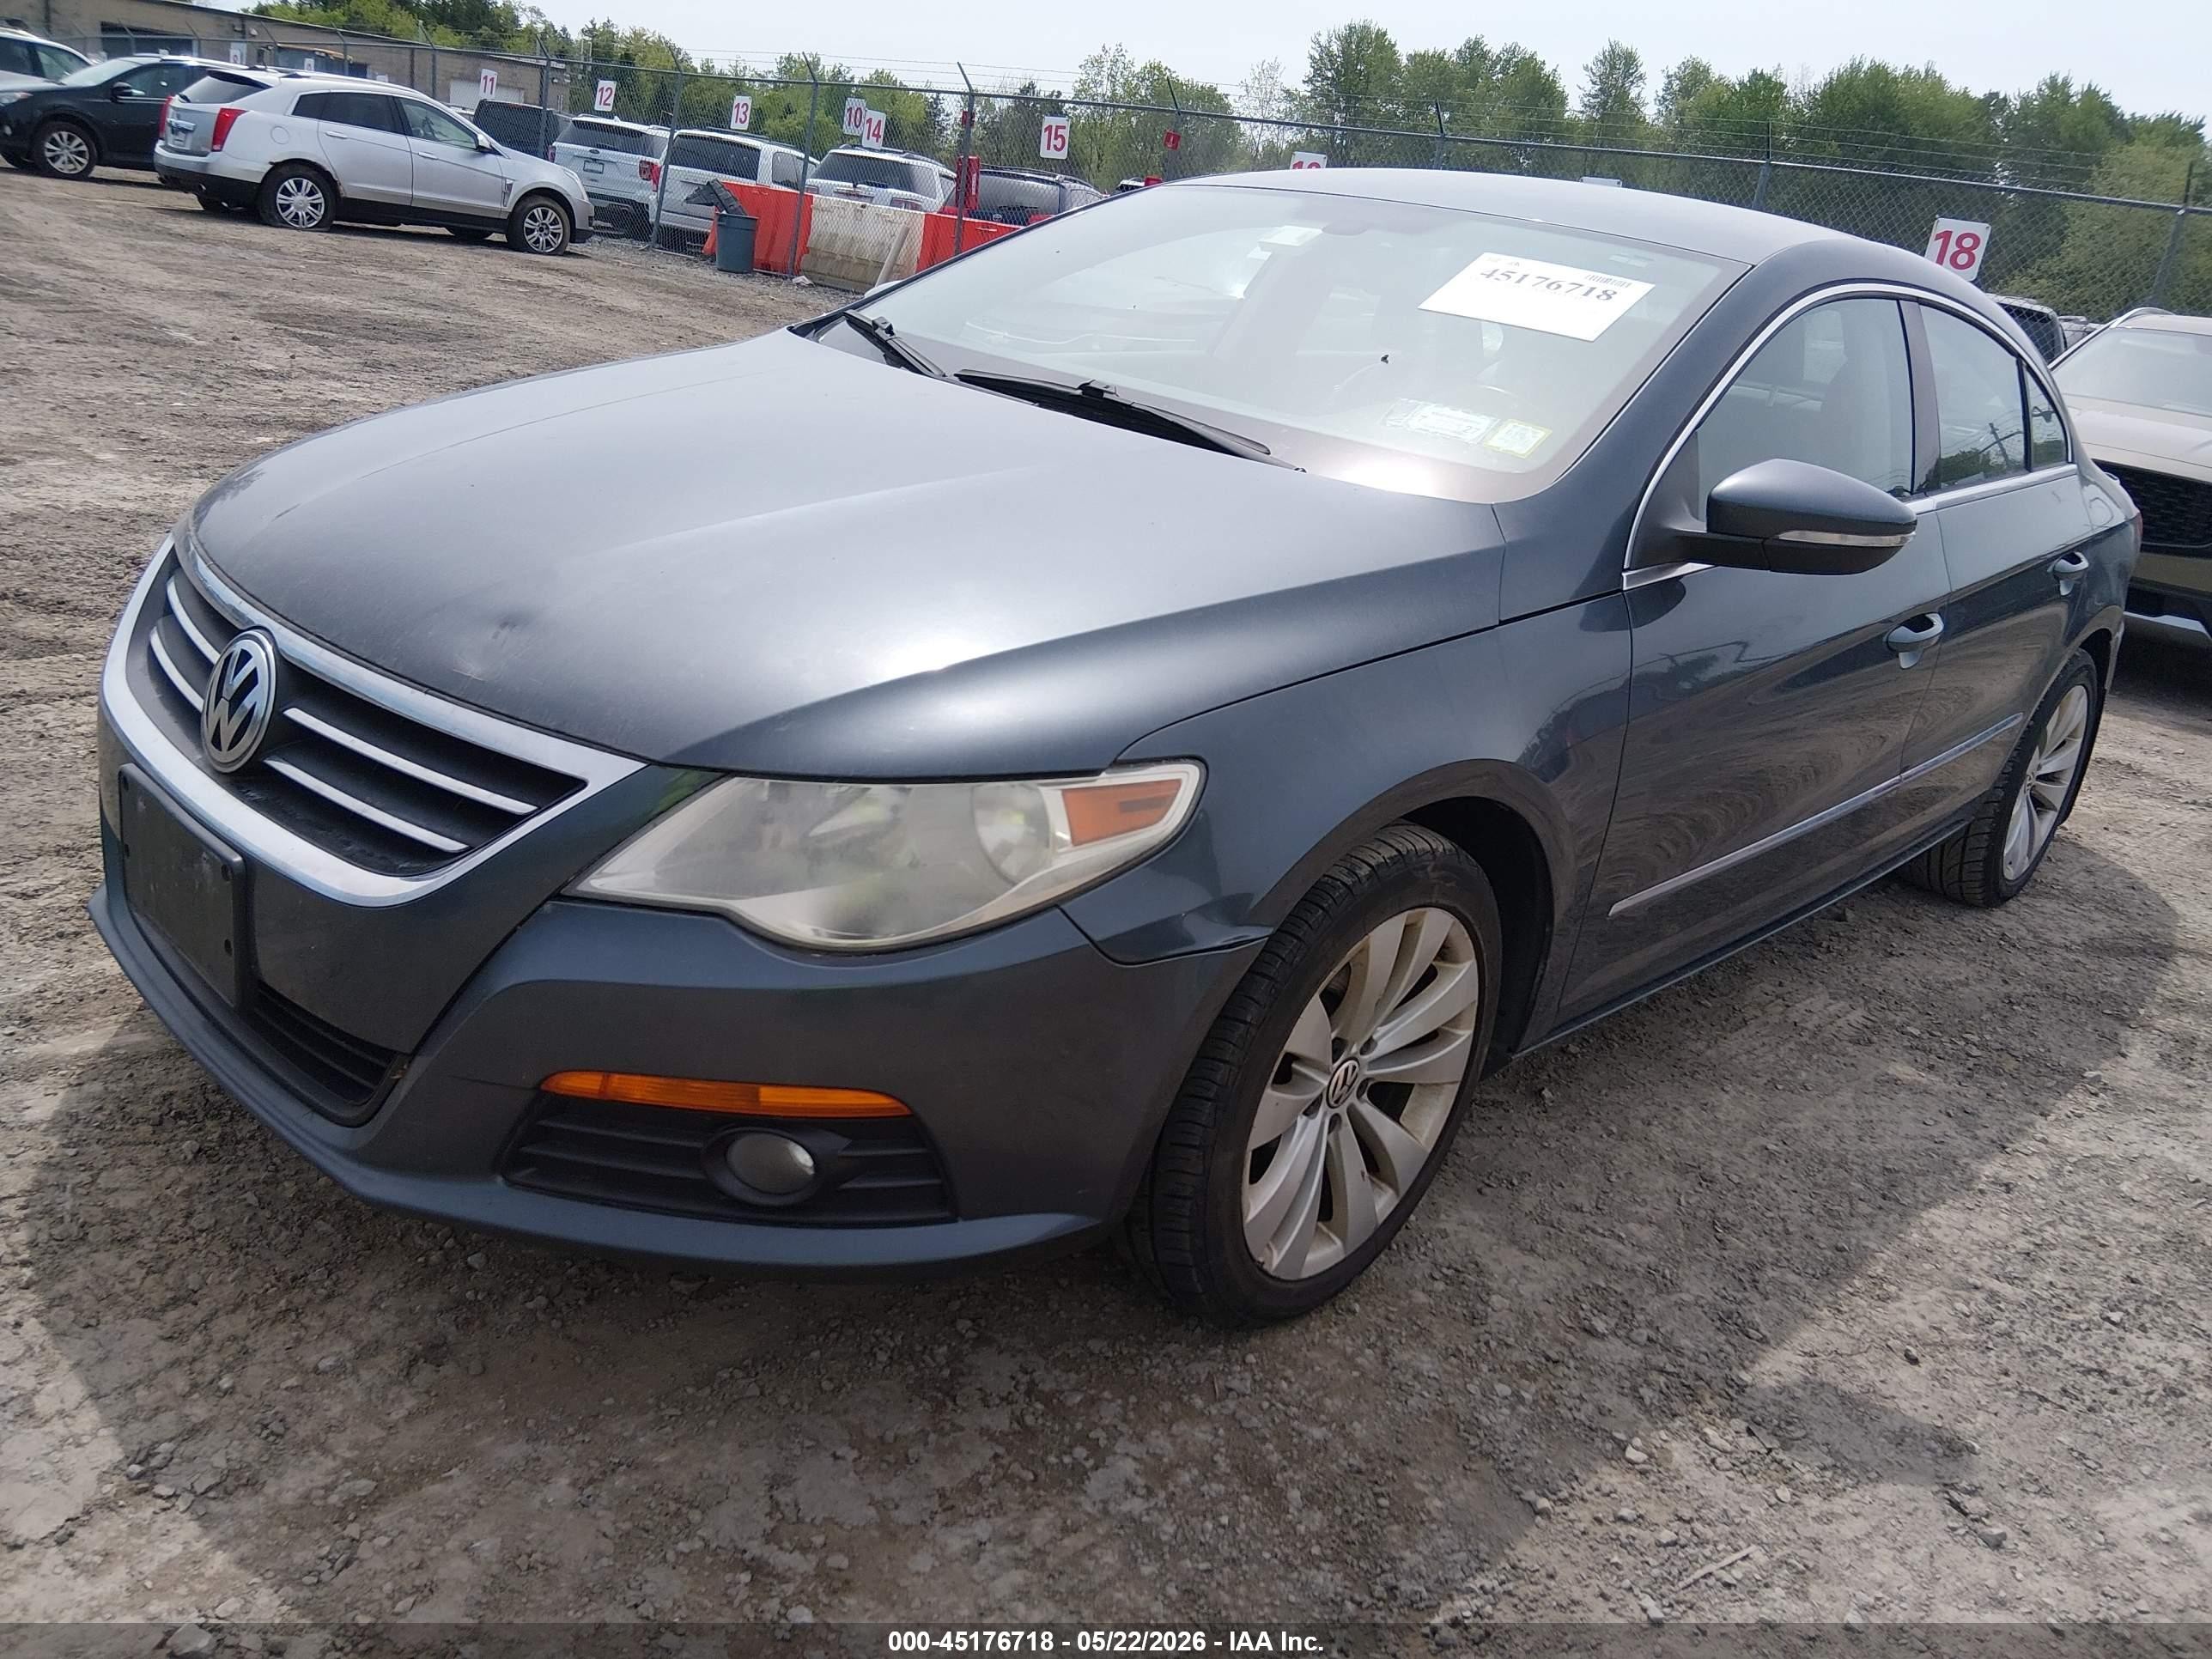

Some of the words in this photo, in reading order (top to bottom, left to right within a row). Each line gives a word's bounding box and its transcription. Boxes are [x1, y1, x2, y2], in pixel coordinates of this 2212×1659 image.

[483, 75, 495, 95] 11
[599, 87, 613, 106] 12
[734, 102, 749, 125] 13
[846, 106, 864, 129] 10
[866, 117, 882, 143] 14
[1044, 125, 1066, 152] 15
[1934, 230, 1981, 270] 18
[1480, 268, 1618, 301] 45176718
[207, 639, 270, 763] VW
